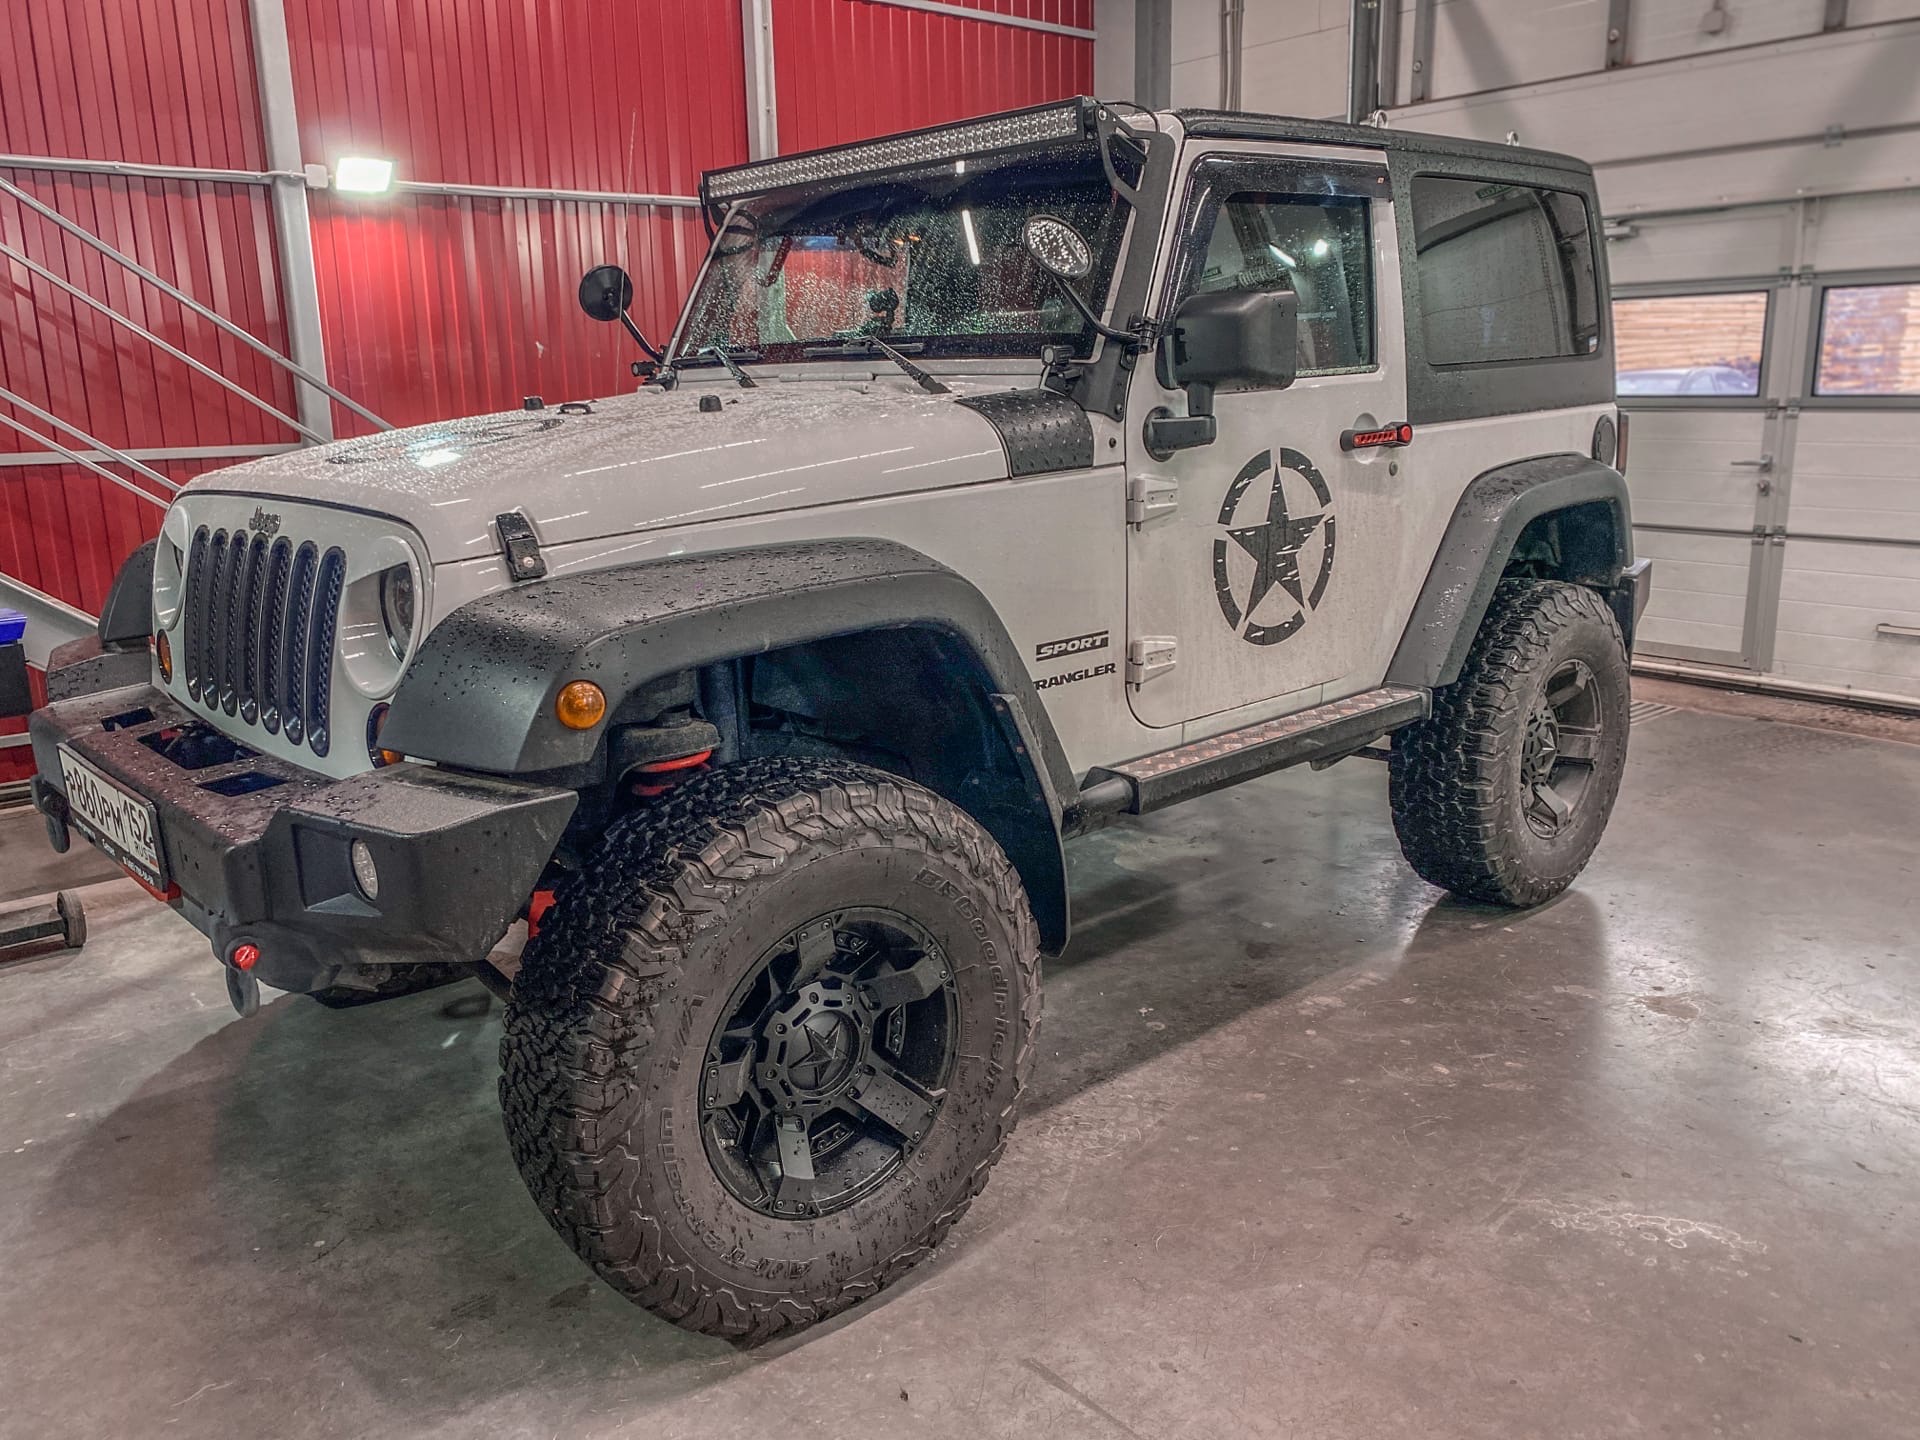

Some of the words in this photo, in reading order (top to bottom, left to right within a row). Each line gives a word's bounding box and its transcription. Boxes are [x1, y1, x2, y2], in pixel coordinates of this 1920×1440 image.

[1037, 633, 1108, 659] SPORT
[1034, 663, 1116, 690] RANGLER
[67, 767, 127, 843] P860PM
[123, 800, 153, 849] 152
